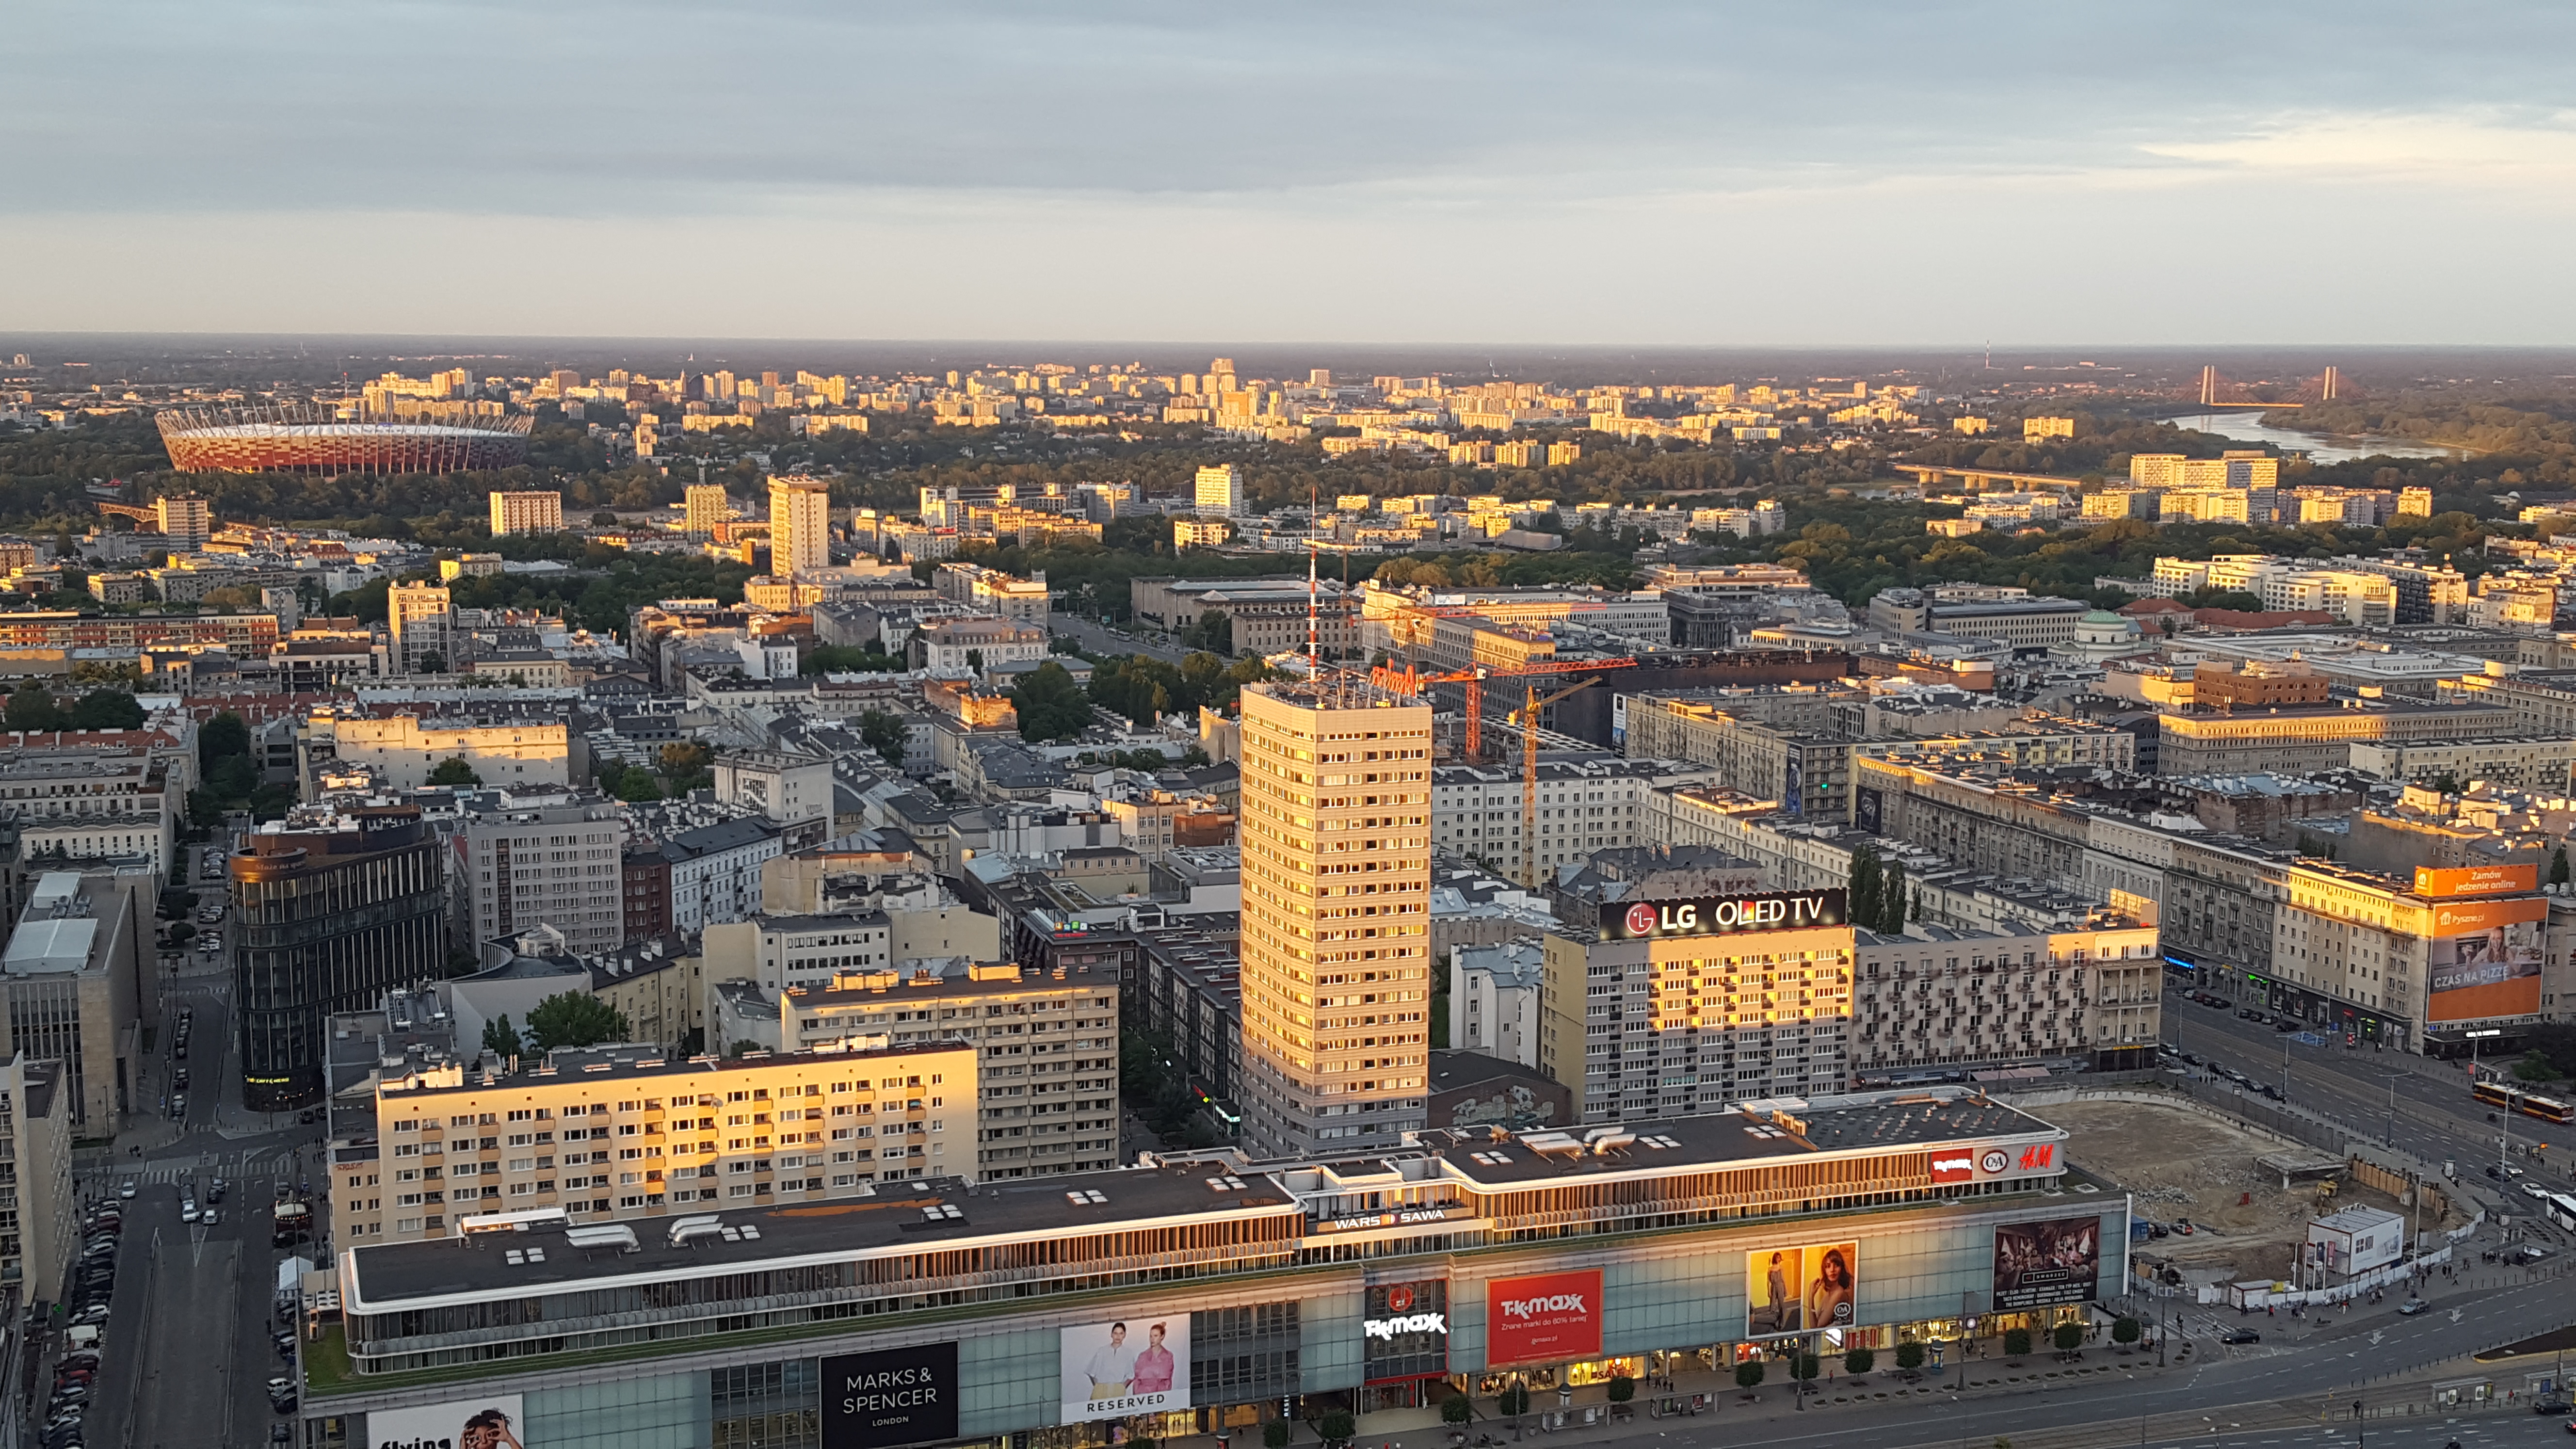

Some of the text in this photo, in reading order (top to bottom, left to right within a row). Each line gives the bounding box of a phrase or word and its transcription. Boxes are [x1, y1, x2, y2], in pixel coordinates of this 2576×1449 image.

[2471, 870, 2502, 881] Zamów
[2491, 880, 2516, 889] online
[1662, 897, 1823, 930] LG OLED TV
[2452, 914, 2485, 925] Pyszne.pl
[2434, 974, 2462, 988] CZAS
[2464, 971, 2478, 983] NA
[1985, 1155, 2003, 1167] C&A
[2019, 1144, 2054, 1170] H&M
[1335, 1210, 1445, 1229] WARS SAWA
[1523, 1320, 1541, 1328] marki
[847, 1367, 932, 1392] MARKS &
[842, 1387, 937, 1414] SPENCER
[1087, 1394, 1165, 1413] RESERVED
[872, 1416, 909, 1427] LONDON
